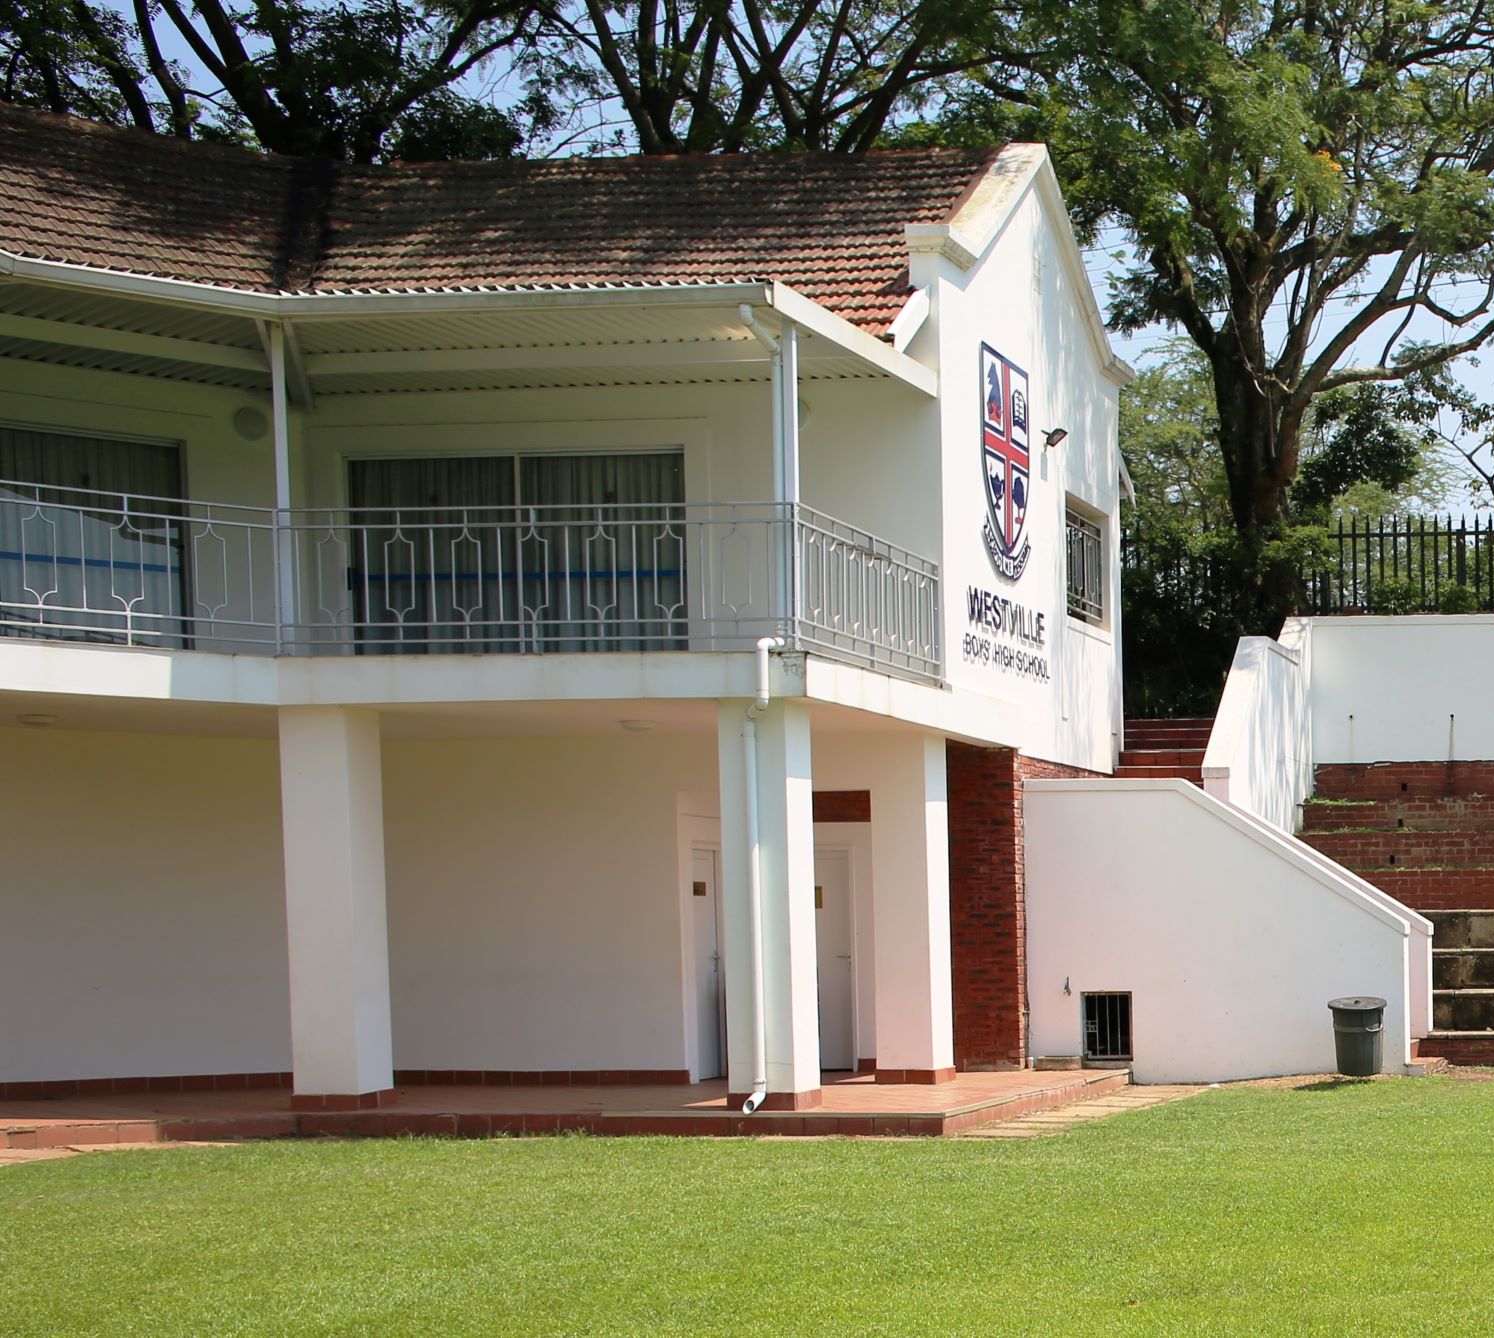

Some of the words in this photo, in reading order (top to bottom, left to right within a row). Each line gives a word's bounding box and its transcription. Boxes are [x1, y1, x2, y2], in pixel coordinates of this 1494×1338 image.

[967, 585, 1045, 645] WESTVILLE
[994, 642, 1015, 669] HIGH
[1015, 650, 1050, 679] SCHOOL
